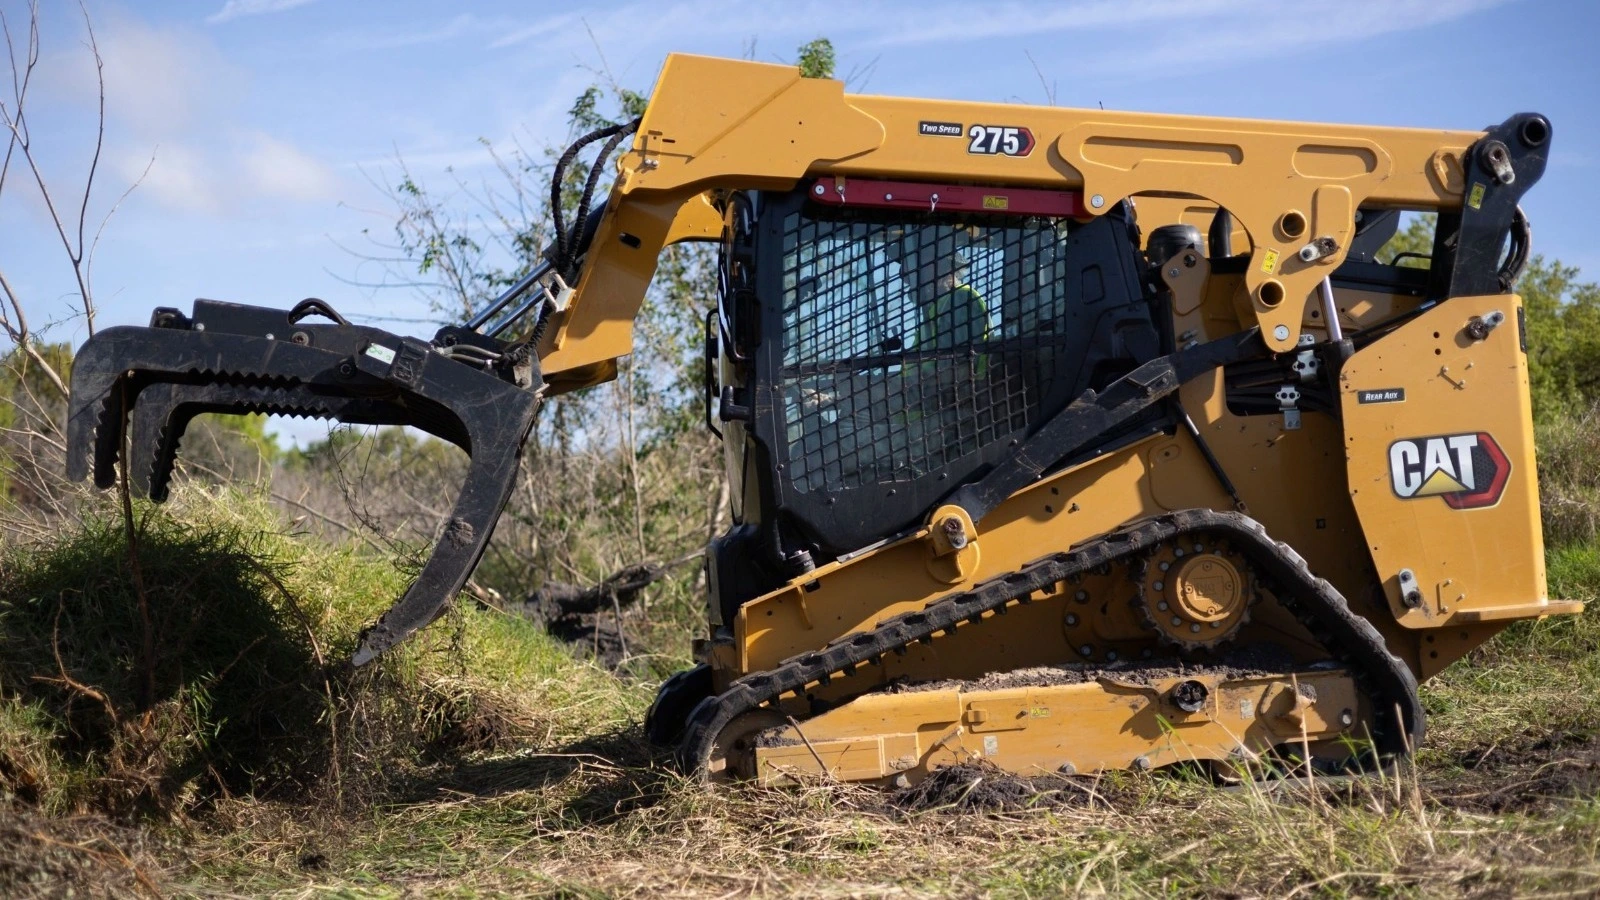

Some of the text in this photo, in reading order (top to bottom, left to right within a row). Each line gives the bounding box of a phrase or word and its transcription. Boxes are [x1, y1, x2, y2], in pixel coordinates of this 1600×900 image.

[922, 124, 960, 134] TWO SPEED
[969, 126, 1019, 154] 275
[1365, 393, 1383, 401] REAR
[1390, 434, 1478, 497] CAT
